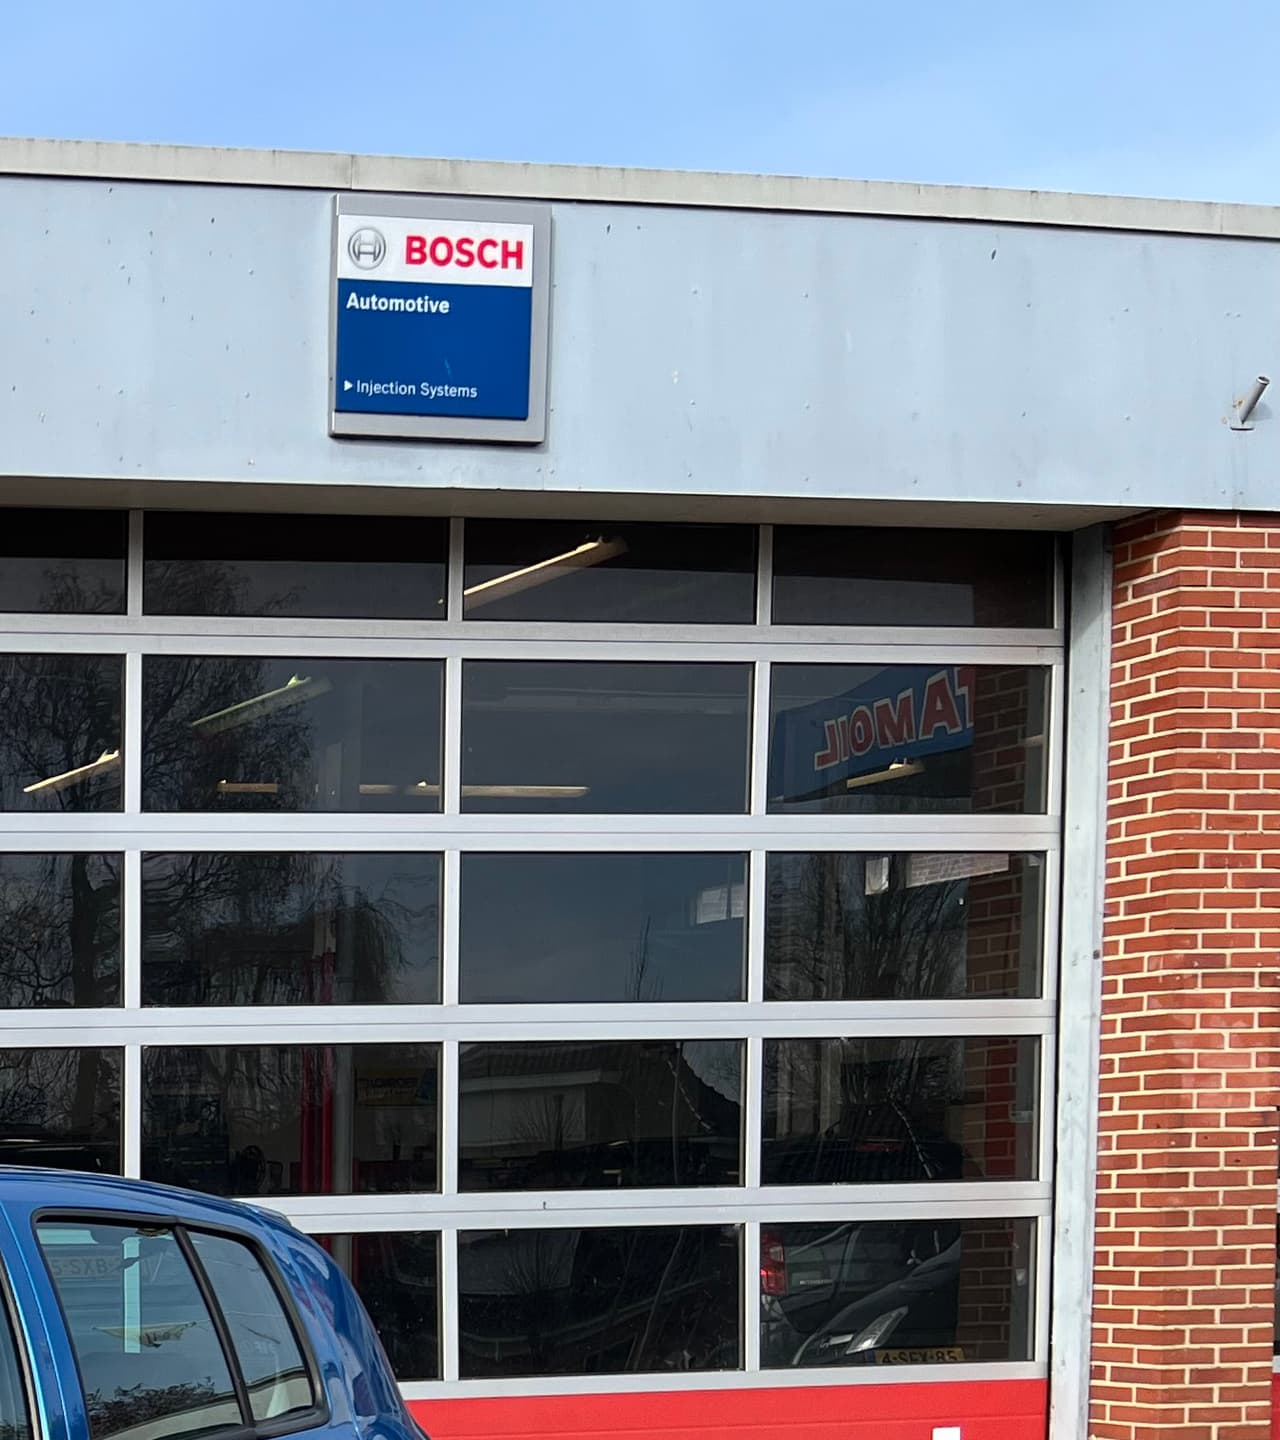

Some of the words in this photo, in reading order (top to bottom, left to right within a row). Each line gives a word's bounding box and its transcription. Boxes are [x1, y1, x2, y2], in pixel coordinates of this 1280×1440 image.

[404, 235, 524, 270] BOSCH
[345, 292, 451, 314] Automotive
[356, 379, 416, 397] Injection
[420, 382, 478, 399] Systems
